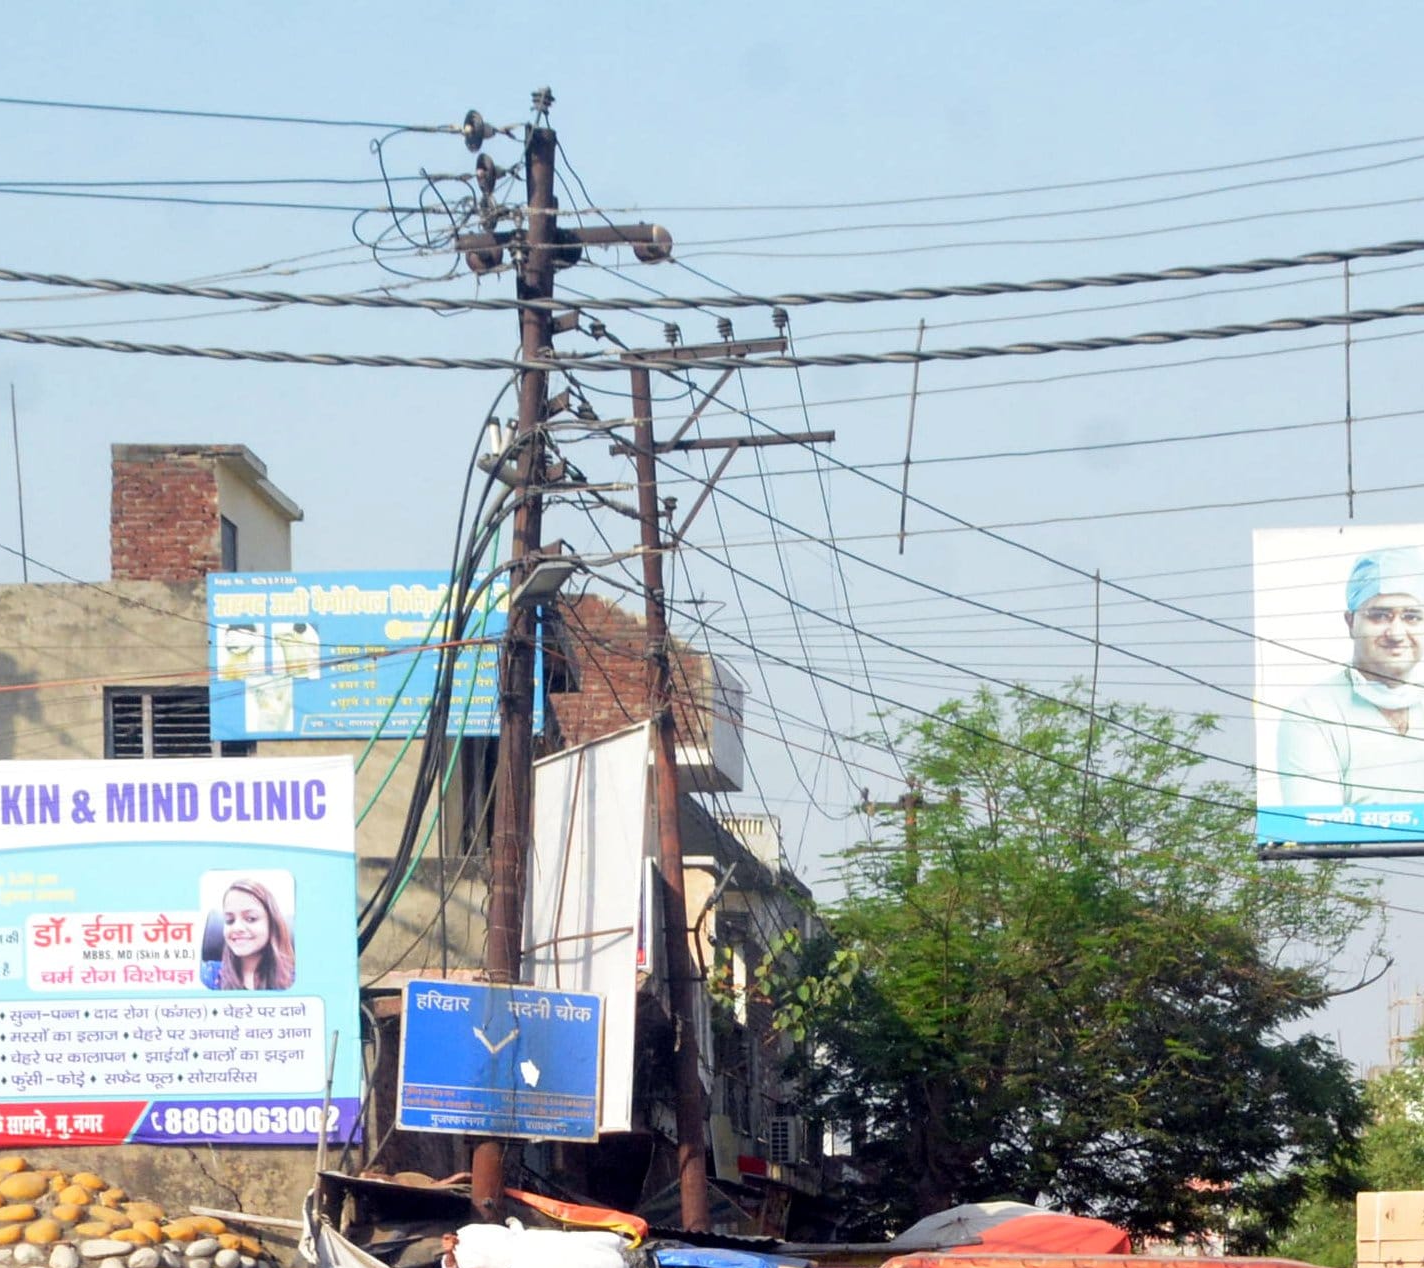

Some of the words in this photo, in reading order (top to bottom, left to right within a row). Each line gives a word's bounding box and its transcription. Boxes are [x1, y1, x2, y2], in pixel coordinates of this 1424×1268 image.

[71, 789, 96, 824] &
[106, 782, 198, 823] MIND
[210, 779, 326, 822] CLINIC
[33, 917, 72, 947] डॉ.
[82, 915, 133, 948] ईना
[143, 913, 193, 944] जैन
[117, 950, 133, 961] MD
[136, 949, 160, 961] (Skin
[41, 966, 72, 985] चर्म
[81, 966, 114, 984] रोग
[123, 965, 194, 985] विशेषज्ञ
[416, 989, 471, 1012] हरिद्वार
[93, 1008, 118, 1019] दाद
[124, 1004, 149, 1019] रोग
[154, 1003, 208, 1022] (फंगल)
[223, 1003, 253, 1019] चेहरे
[257, 1006, 276, 1018] पर
[279, 1003, 306, 1017] दाने
[10, 1028, 50, 1043] मस्सों
[52, 1031, 72, 1042] का
[76, 1030, 118, 1043] इलाज
[133, 1026, 162, 1042] चेहरे
[167, 1028, 185, 1040] पर
[189, 1025, 240, 1041] अनचाहे
[245, 1028, 273, 1039] बाल
[277, 1027, 312, 1039] आना
[10, 1050, 41, 1066] चेहरे
[45, 1053, 63, 1064] पर
[67, 1051, 126, 1063] कालापन
[202, 1047, 237, 1062] बालों
[240, 1049, 259, 1061] का
[104, 1070, 141, 1085] सफेद
[146, 1072, 174, 1089] फूल
[187, 1067, 258, 1084] सोरायसिस
[6, 1109, 52, 1138] सामने,
[165, 1105, 340, 1135] 8868063002
